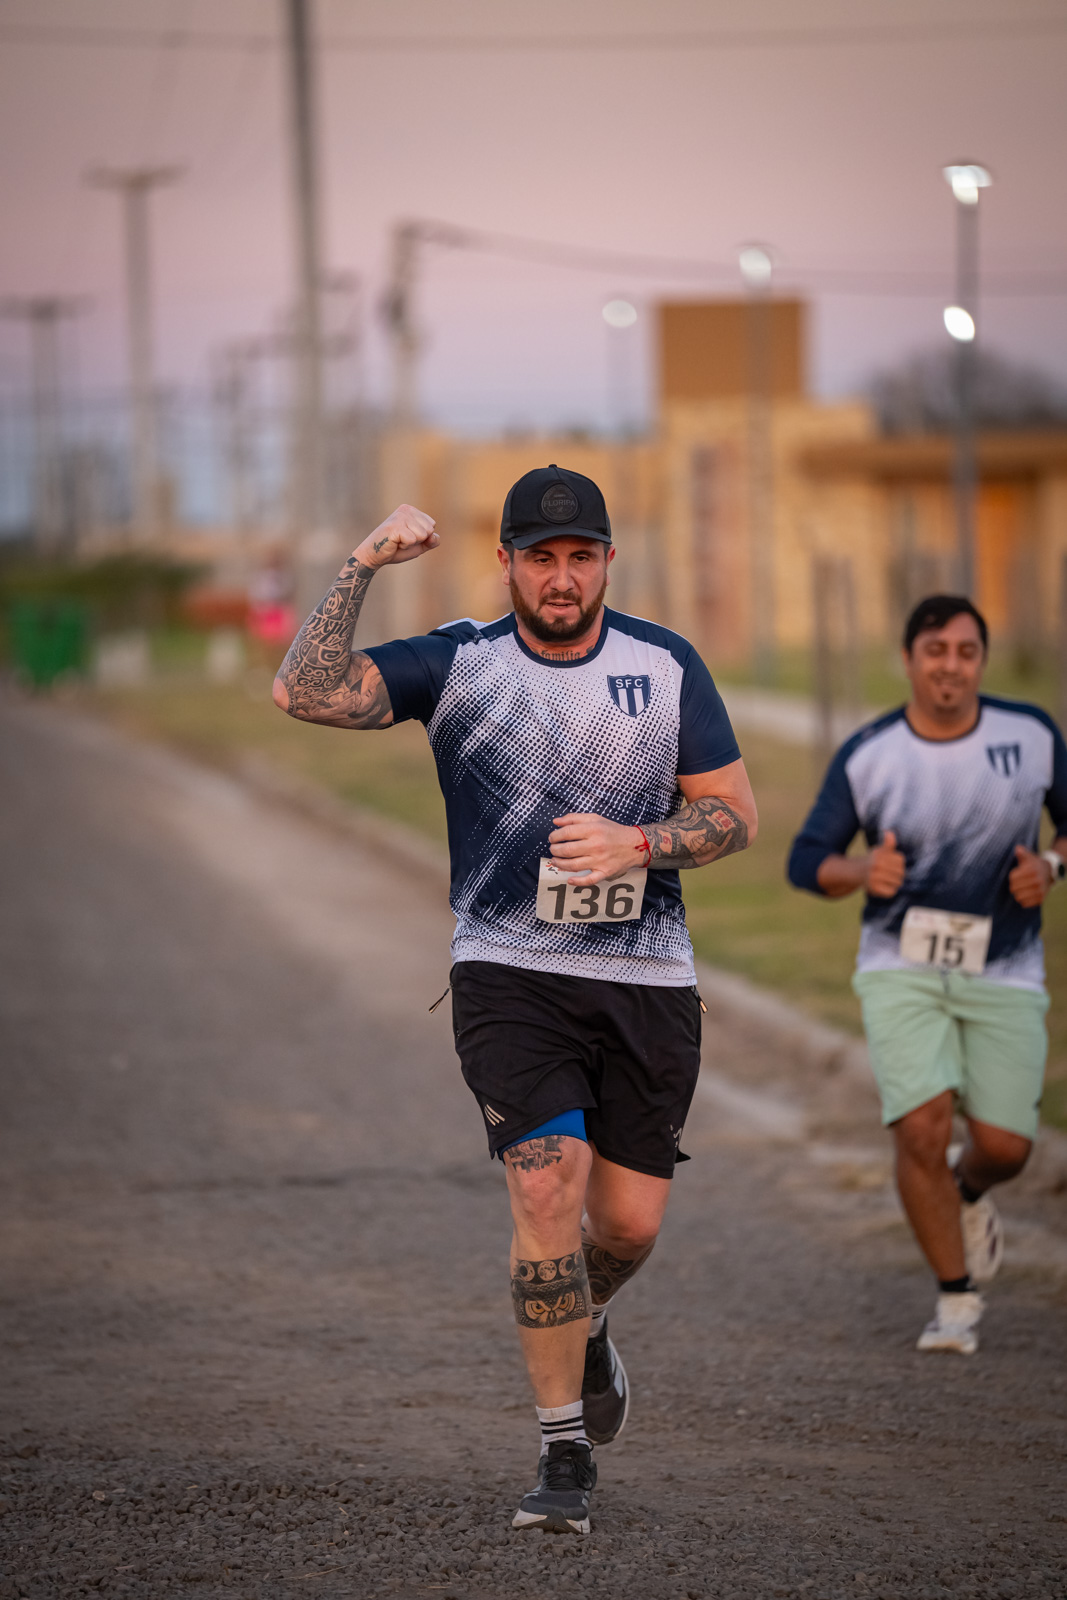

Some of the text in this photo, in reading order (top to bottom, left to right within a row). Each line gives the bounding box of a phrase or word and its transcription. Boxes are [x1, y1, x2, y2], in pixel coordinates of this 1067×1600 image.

[543, 499, 576, 508] FLORIPA
[615, 678, 643, 688] SFC
[547, 883, 635, 920] 136
[924, 933, 964, 968] 15
